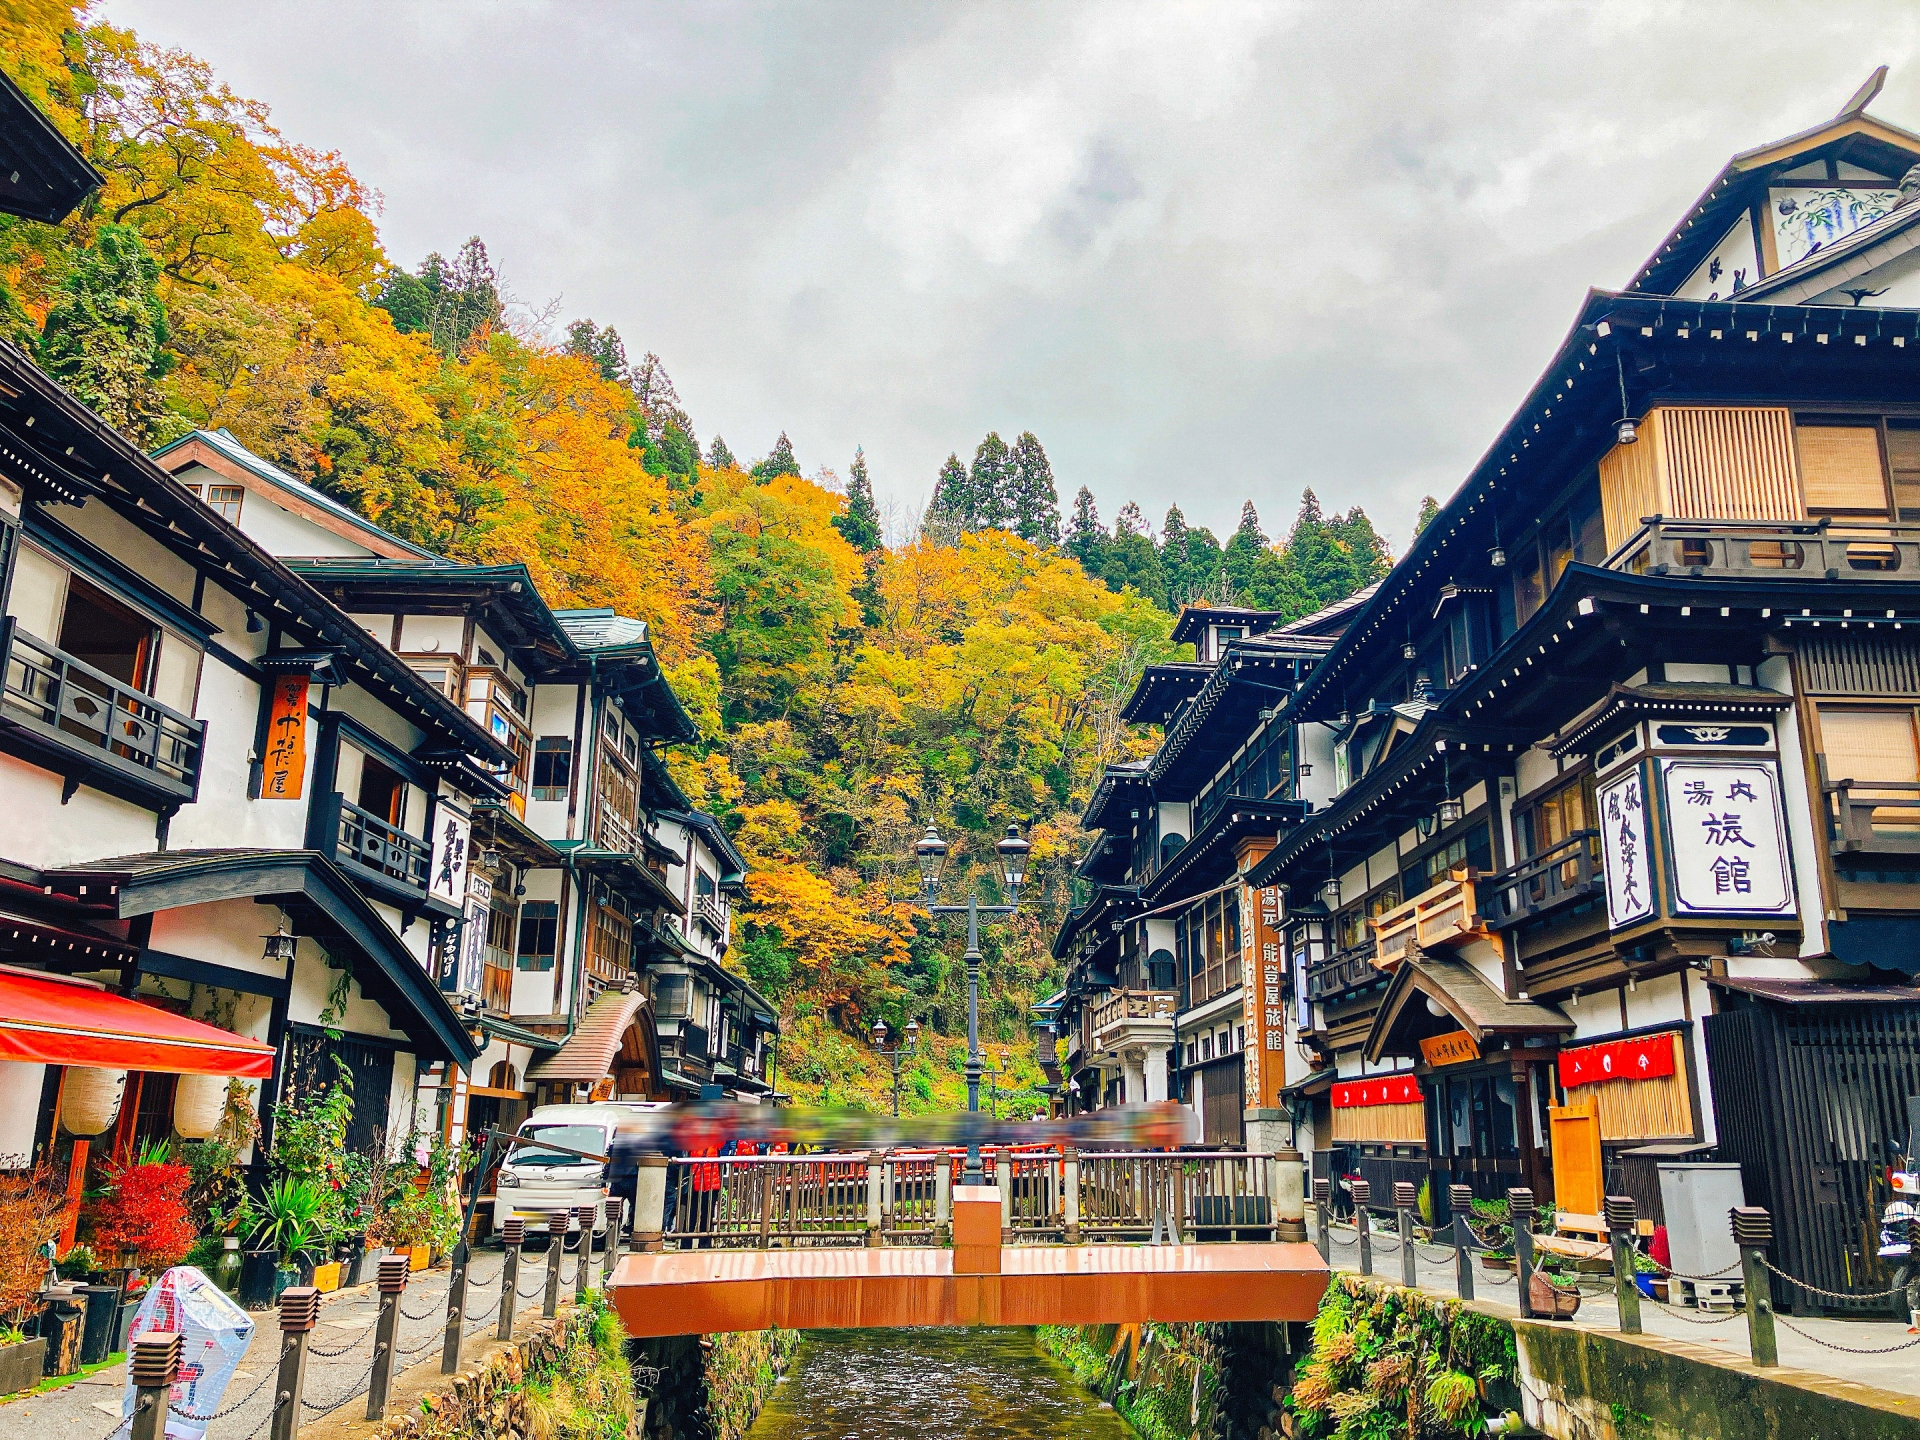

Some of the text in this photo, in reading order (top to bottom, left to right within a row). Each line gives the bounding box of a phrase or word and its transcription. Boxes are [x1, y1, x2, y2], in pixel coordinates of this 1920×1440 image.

[269, 711, 301, 794] やなだ屋
[1681, 779, 1758, 806] 内湯
[1701, 812, 1756, 895] 旅館
[1261, 886, 1283, 1051] 湯元 能登屋旅館
